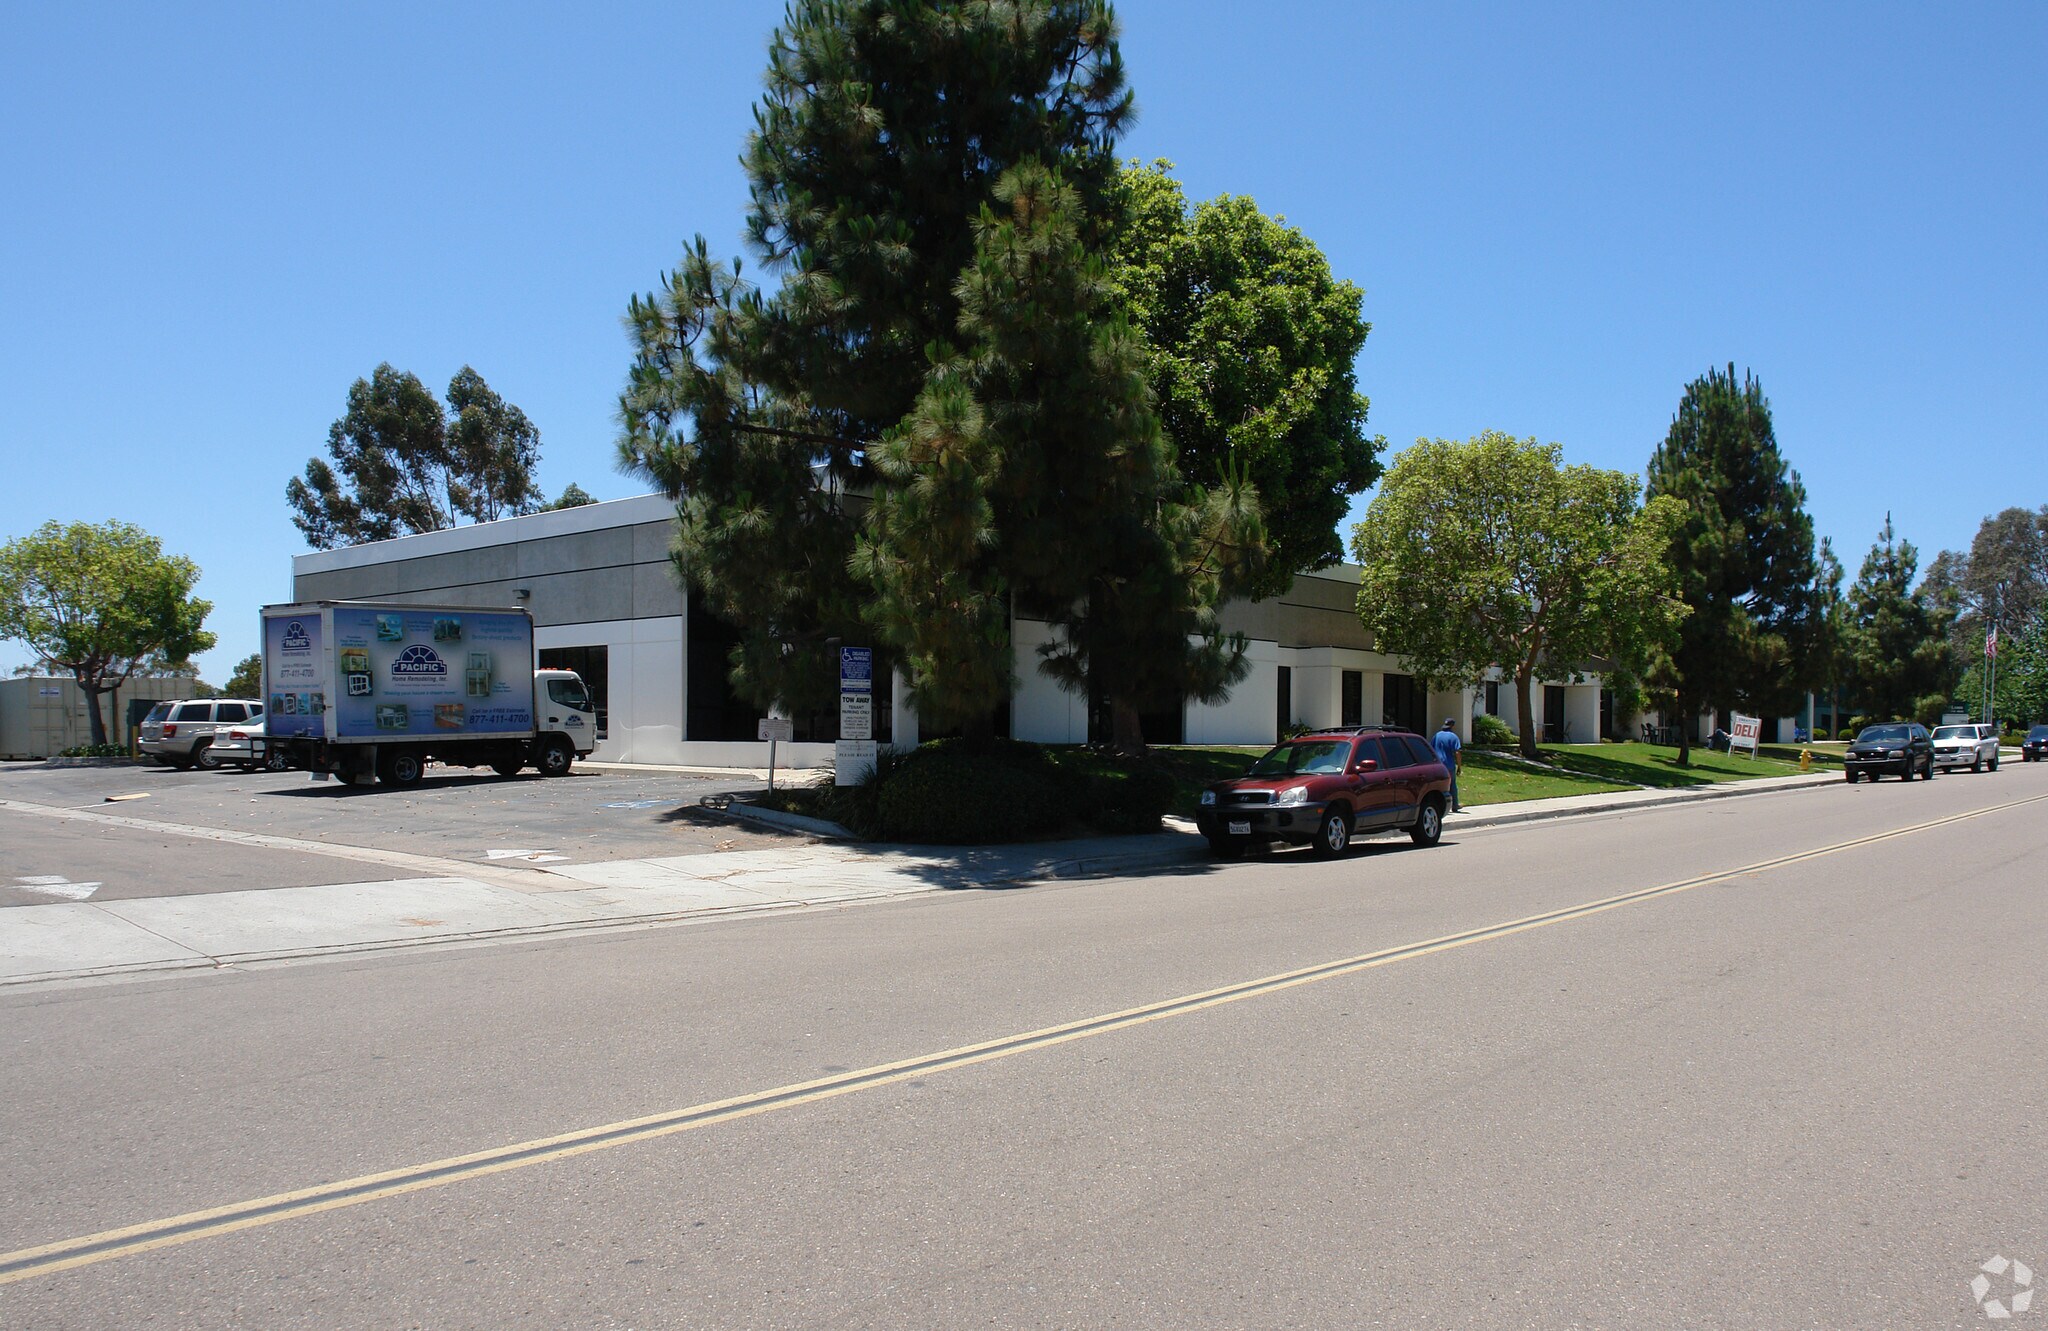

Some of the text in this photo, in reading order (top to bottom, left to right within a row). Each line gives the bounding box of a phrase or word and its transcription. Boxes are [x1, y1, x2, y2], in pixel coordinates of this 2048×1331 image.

[400, 663, 439, 671] PACIFIC
[281, 669, 314, 678] 877-411-4700
[469, 714, 529, 724] 877-411-4700
[1734, 724, 1757, 738] DELI
